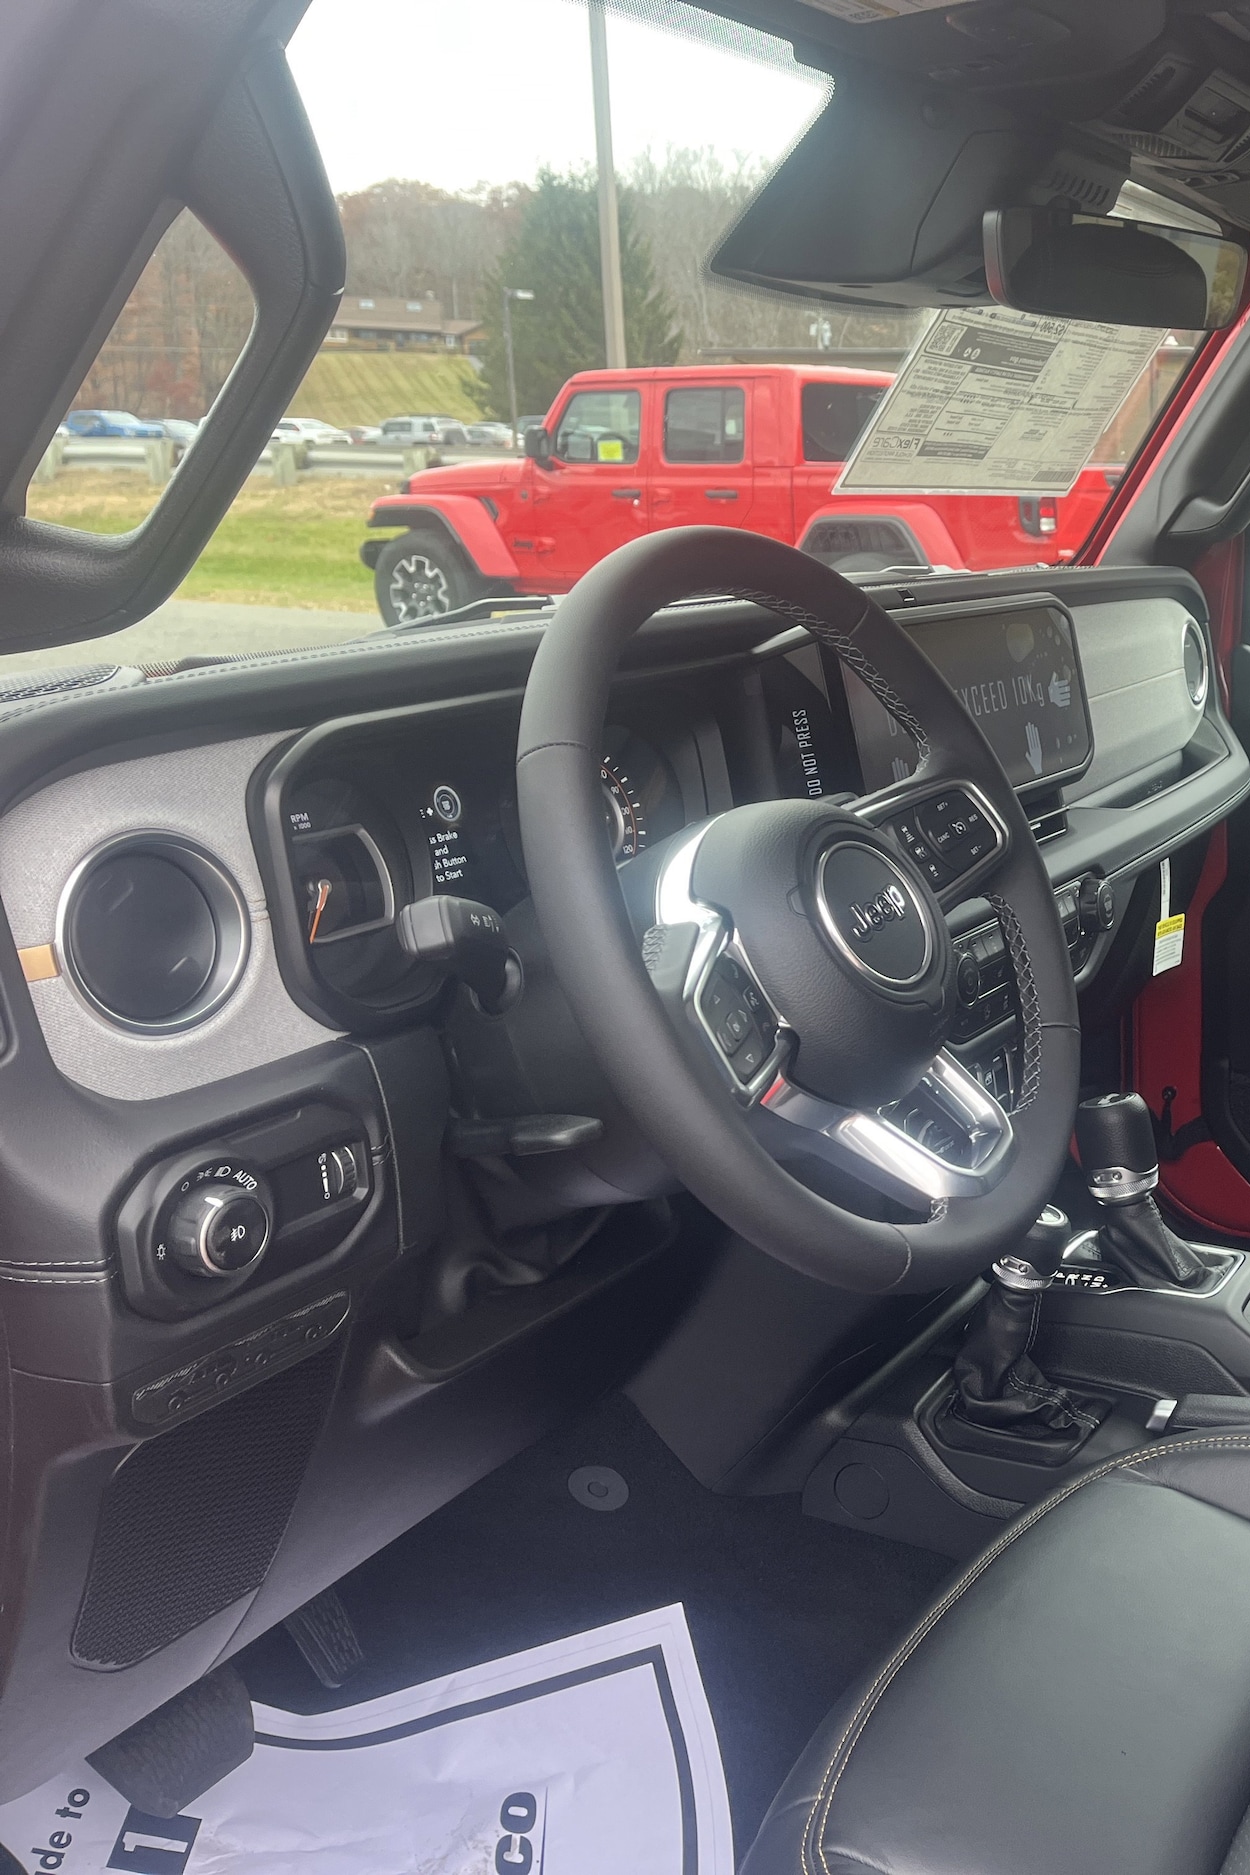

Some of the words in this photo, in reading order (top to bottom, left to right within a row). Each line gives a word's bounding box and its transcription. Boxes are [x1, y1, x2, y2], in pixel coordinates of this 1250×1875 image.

[792, 709, 813, 748] PRESS
[801, 753, 819, 776] NOT
[807, 779, 823, 796] DO
[290, 812, 310, 824] RPM
[298, 822, 312, 830] 1000
[436, 830, 458, 843] Brake
[434, 845, 449, 857] and
[622, 844, 634, 854] 120
[442, 855, 468, 868] Button
[436, 874, 445, 883] to
[445, 869, 464, 881] Start
[850, 884, 906, 941] Jeep
[232, 1169, 258, 1191] AUTO
[55, 1788, 90, 1819] to
